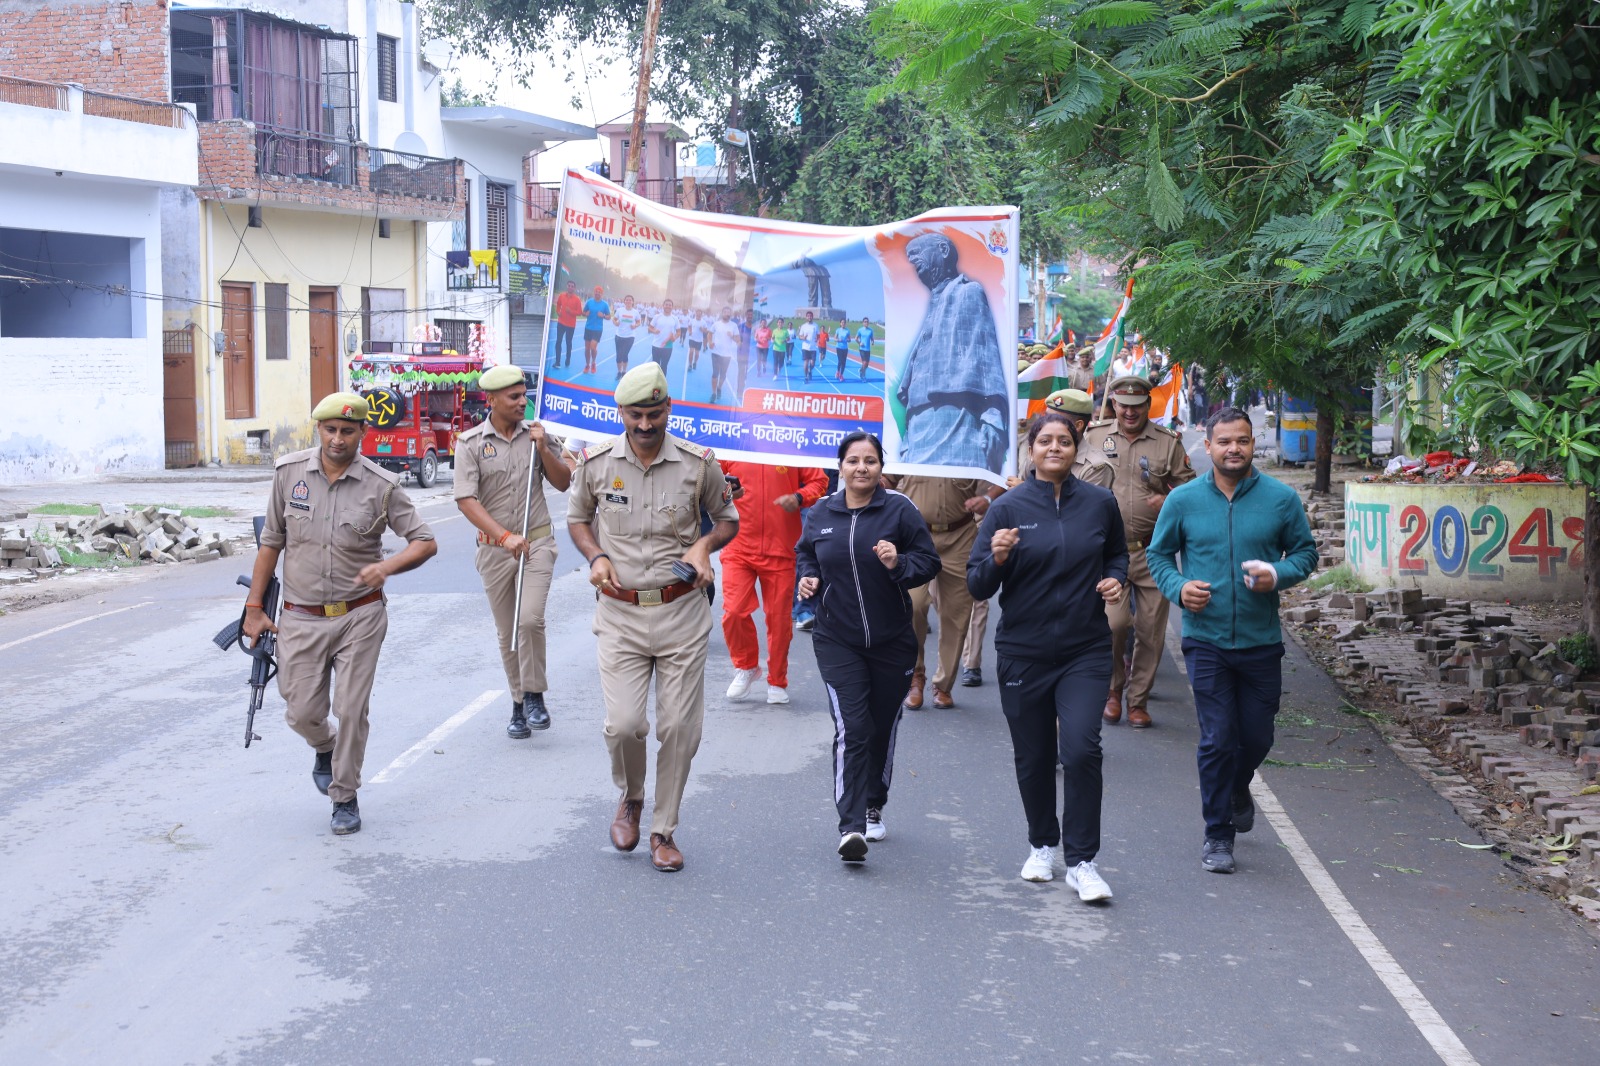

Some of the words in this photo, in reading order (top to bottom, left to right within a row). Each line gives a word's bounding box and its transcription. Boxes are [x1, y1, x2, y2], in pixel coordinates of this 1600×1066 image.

[564, 207, 616, 235] एकता
[569, 228, 595, 242] 150th
[598, 235, 662, 254] Anniversary
[762, 392, 866, 420] #RunForUnity
[544, 393, 579, 415] थाना-
[581, 398, 624, 424] कोतवा
[700, 417, 749, 439] जनपद-
[752, 420, 809, 449] फतेहगढ़,
[374, 434, 396, 443] JMT
[1398, 504, 1568, 583] 2024
